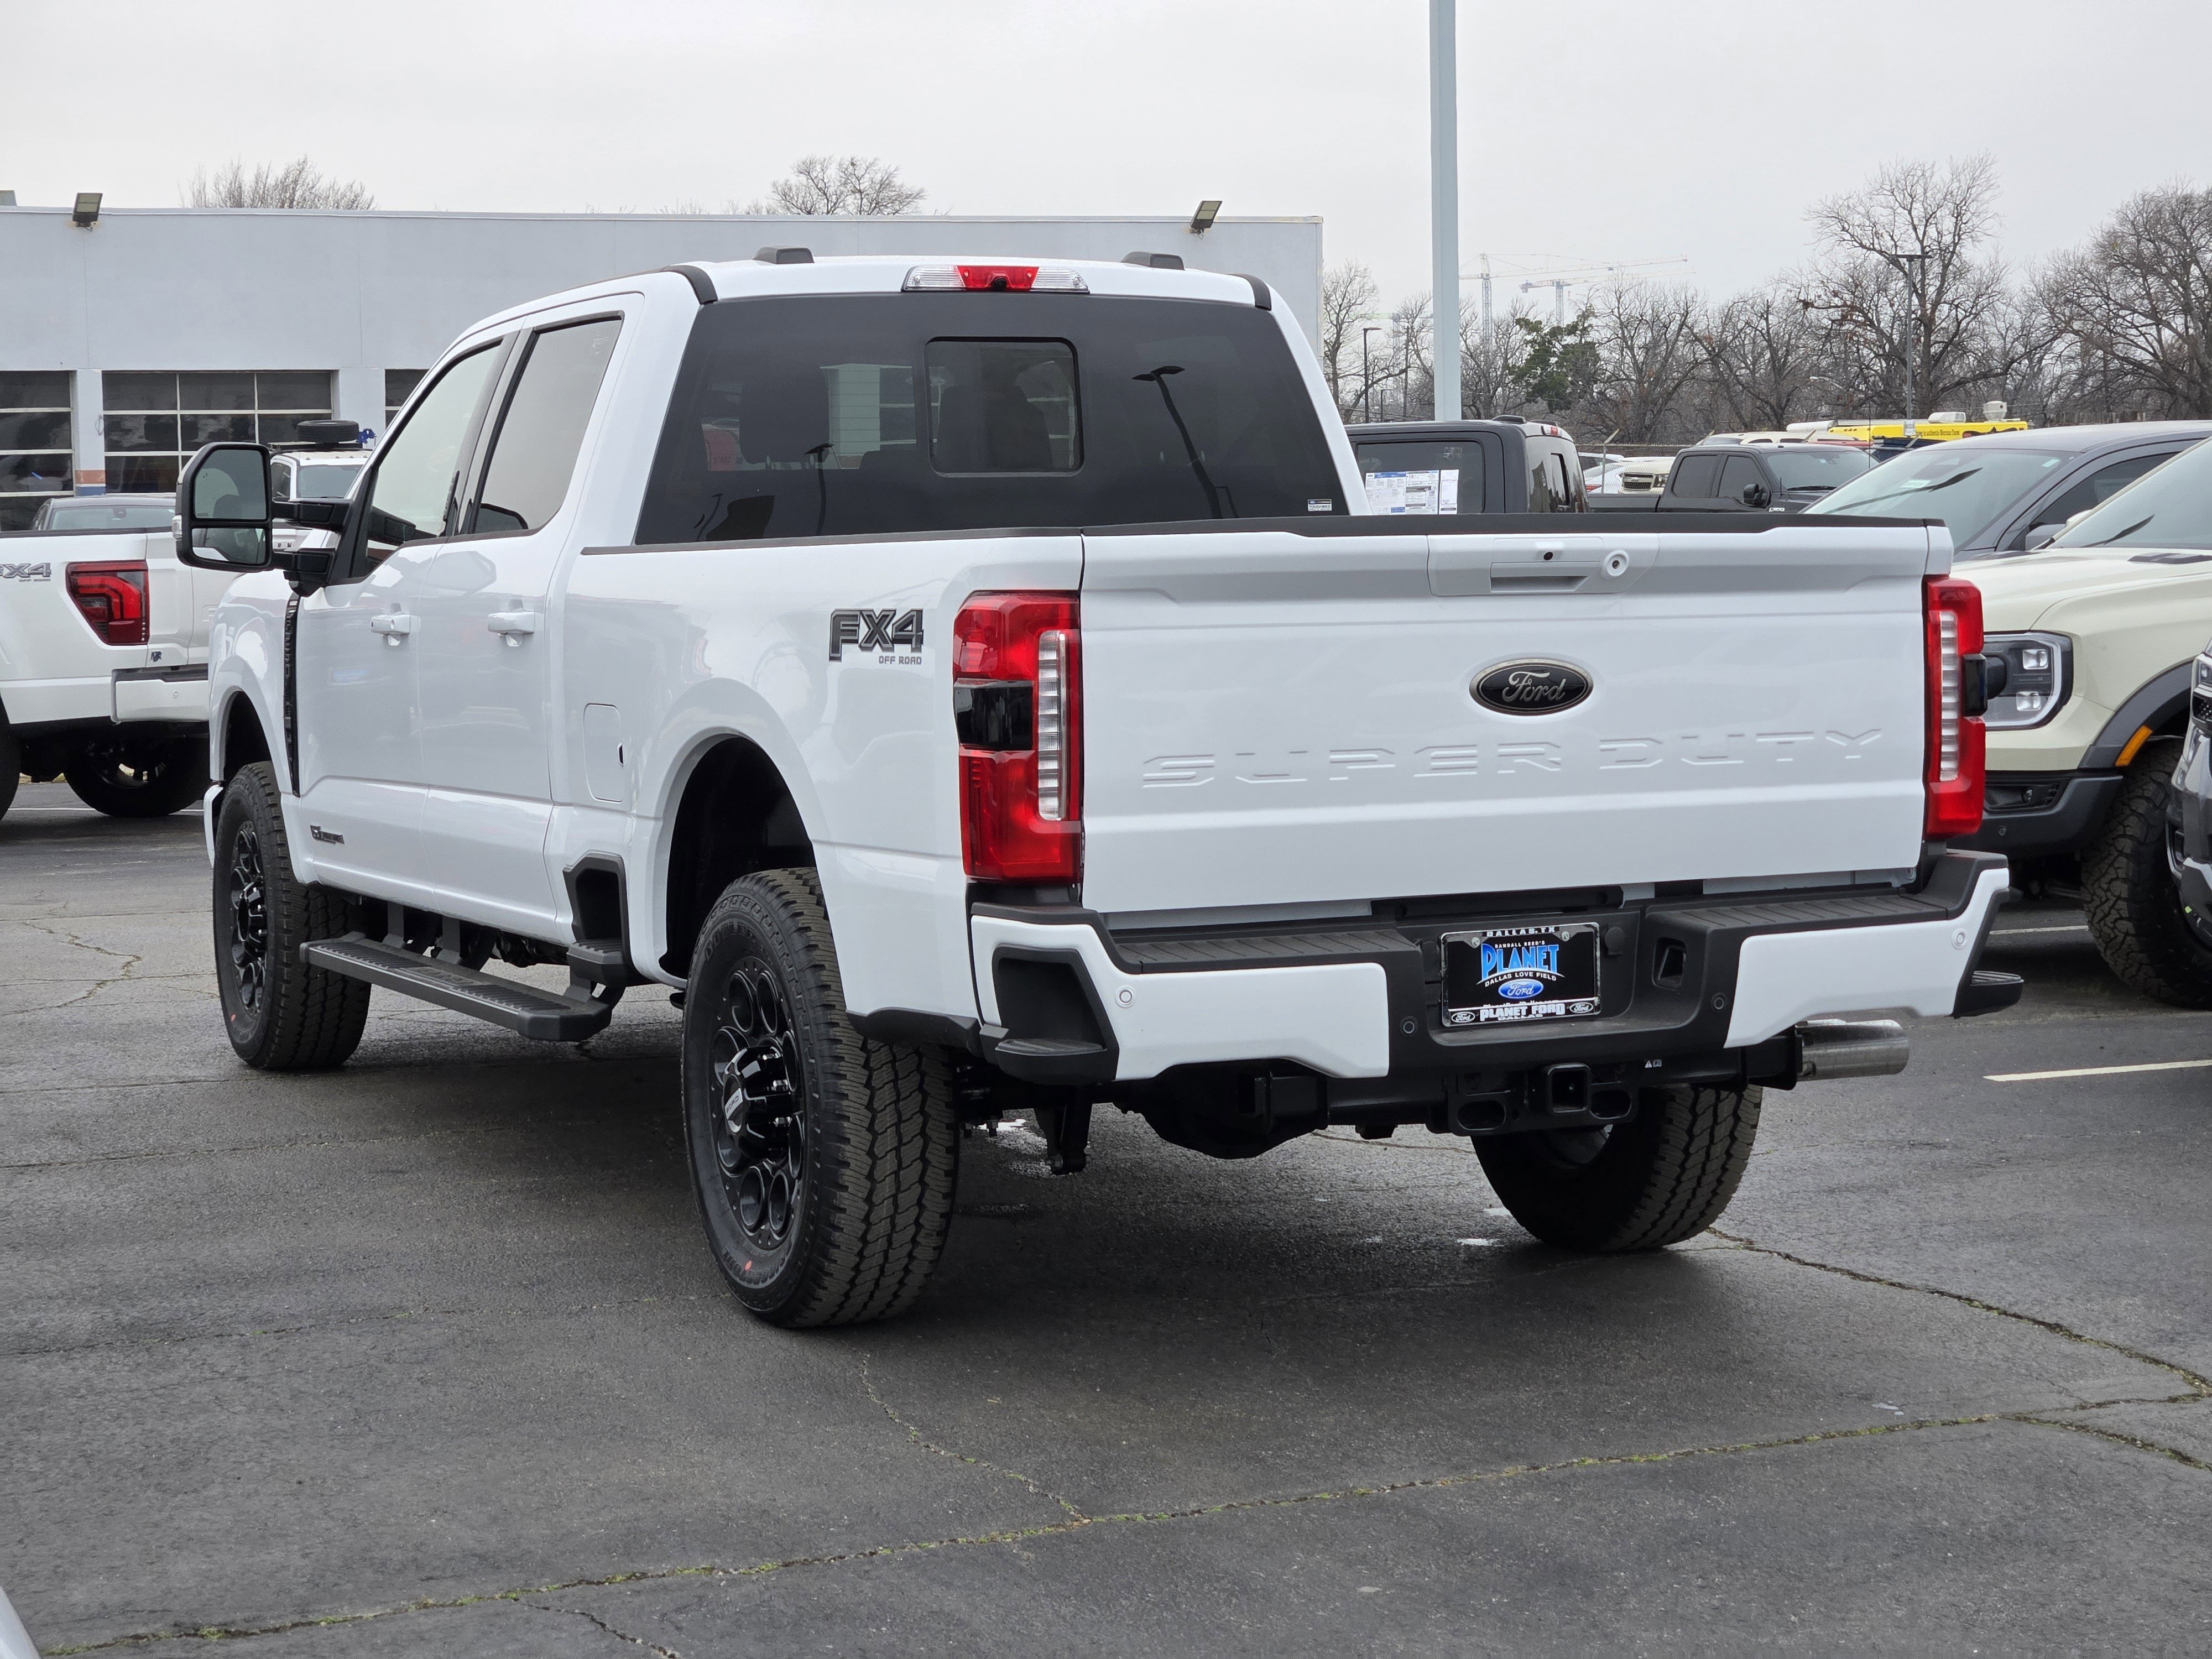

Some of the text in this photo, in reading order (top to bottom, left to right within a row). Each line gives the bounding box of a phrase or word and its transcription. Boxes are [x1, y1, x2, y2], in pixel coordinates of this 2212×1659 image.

[0, 562, 51, 578] X4
[829, 608, 924, 662] FX4
[879, 655, 922, 665] OFF ROAD
[1502, 671, 1566, 702] Ford
[1142, 729, 1881, 788] SUPER DUTY
[1481, 943, 1559, 980] PLANET
[1485, 973, 1512, 987] DALLAS
[1536, 972, 1557, 981] FIELD
[1480, 1006, 1527, 1021] PLANET
[1531, 1003, 1566, 1015] FORD
